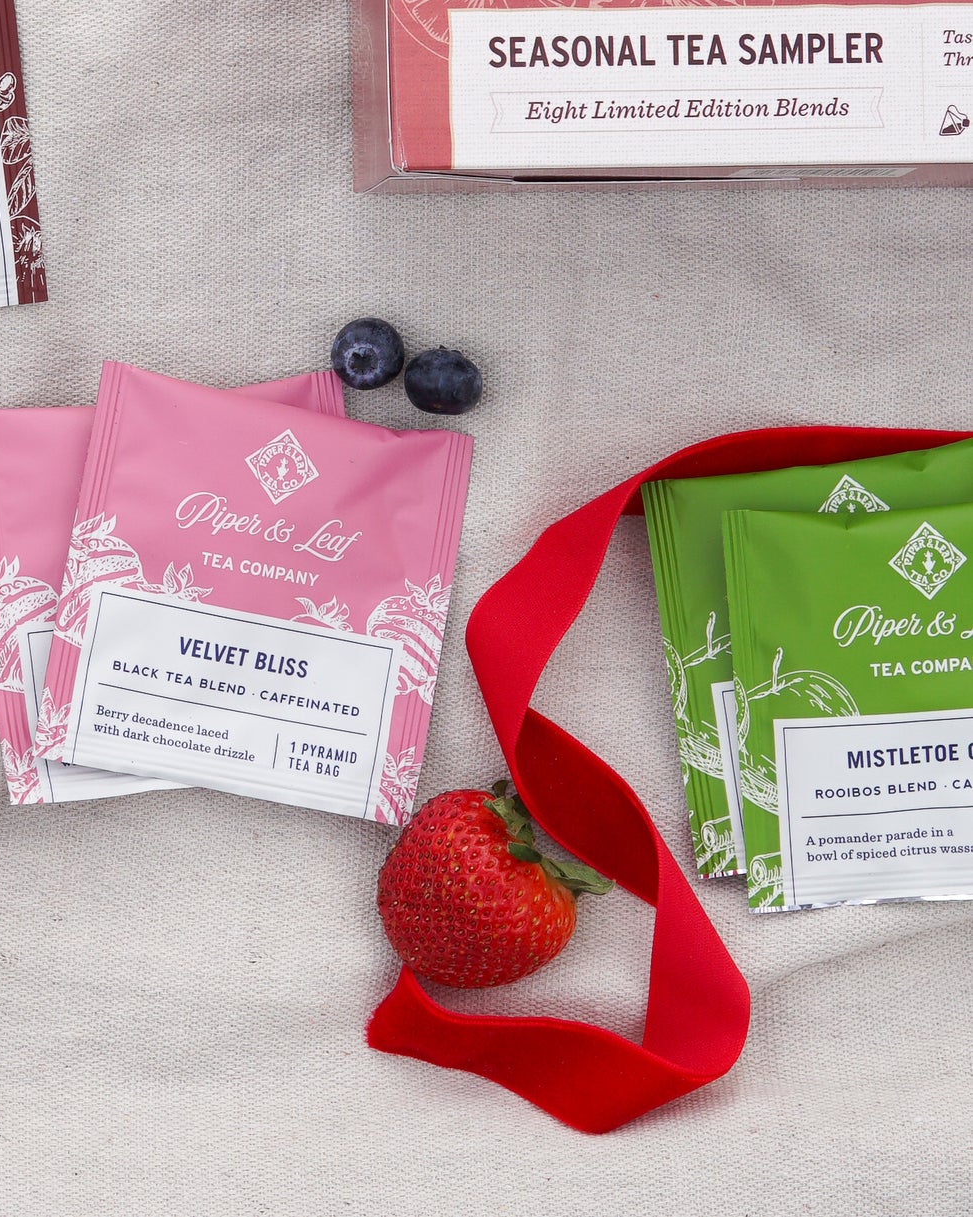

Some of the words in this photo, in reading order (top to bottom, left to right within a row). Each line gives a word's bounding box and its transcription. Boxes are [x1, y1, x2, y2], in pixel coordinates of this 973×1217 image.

[489, 35, 656, 68] SEASONAL
[667, 34, 727, 66] TEA
[739, 33, 883, 65] SAMPLER
[525, 100, 588, 124] Eight
[591, 99, 680, 119] Limited
[684, 99, 769, 118] Edition
[773, 97, 849, 117] Blends
[175, 492, 262, 535] Piper
[264, 519, 295, 543] &
[293, 520, 362, 561] Leaf
[903, 539, 926, 566] PIPER
[926, 538, 933, 549] &
[202, 552, 233, 571] TEA
[240, 560, 319, 586] COMPANY
[910, 570, 928, 584] TEA
[833, 605, 923, 647] Piper
[927, 611, 956, 637] &
[180, 636, 249, 666] VELVET
[254, 652, 308, 678] BLISS
[870, 662, 906, 677] TEA
[113, 660, 159, 679] BLACK
[166, 671, 192, 686] TEA
[199, 678, 245, 695] BLEND
[260, 690, 359, 716] CAFFEINATED
[96, 705, 129, 722] Berry
[132, 712, 194, 733] decadence
[196, 725, 229, 740] laced
[94, 723, 119, 736] with
[123, 728, 149, 742] dark
[153, 734, 211, 753] chocolate
[214, 745, 255, 762] drizzle
[291, 741, 296, 753] 1
[301, 743, 357, 764] PYRAMID
[289, 757, 309, 772] TEA
[316, 762, 340, 777] BAG
[847, 744, 959, 769] MISTLETOE
[815, 786, 881, 799] ROOIBOS
[888, 781, 937, 794] BLEND
[806, 836, 816, 846] A
[818, 832, 882, 847] pomander
[886, 828, 928, 843] parade
[931, 827, 944, 837] in
[947, 829, 954, 837] a
[807, 850, 837, 862] bowl
[841, 849, 854, 860] of
[856, 847, 897, 861] spiced
[900, 845, 937, 856] citrus
